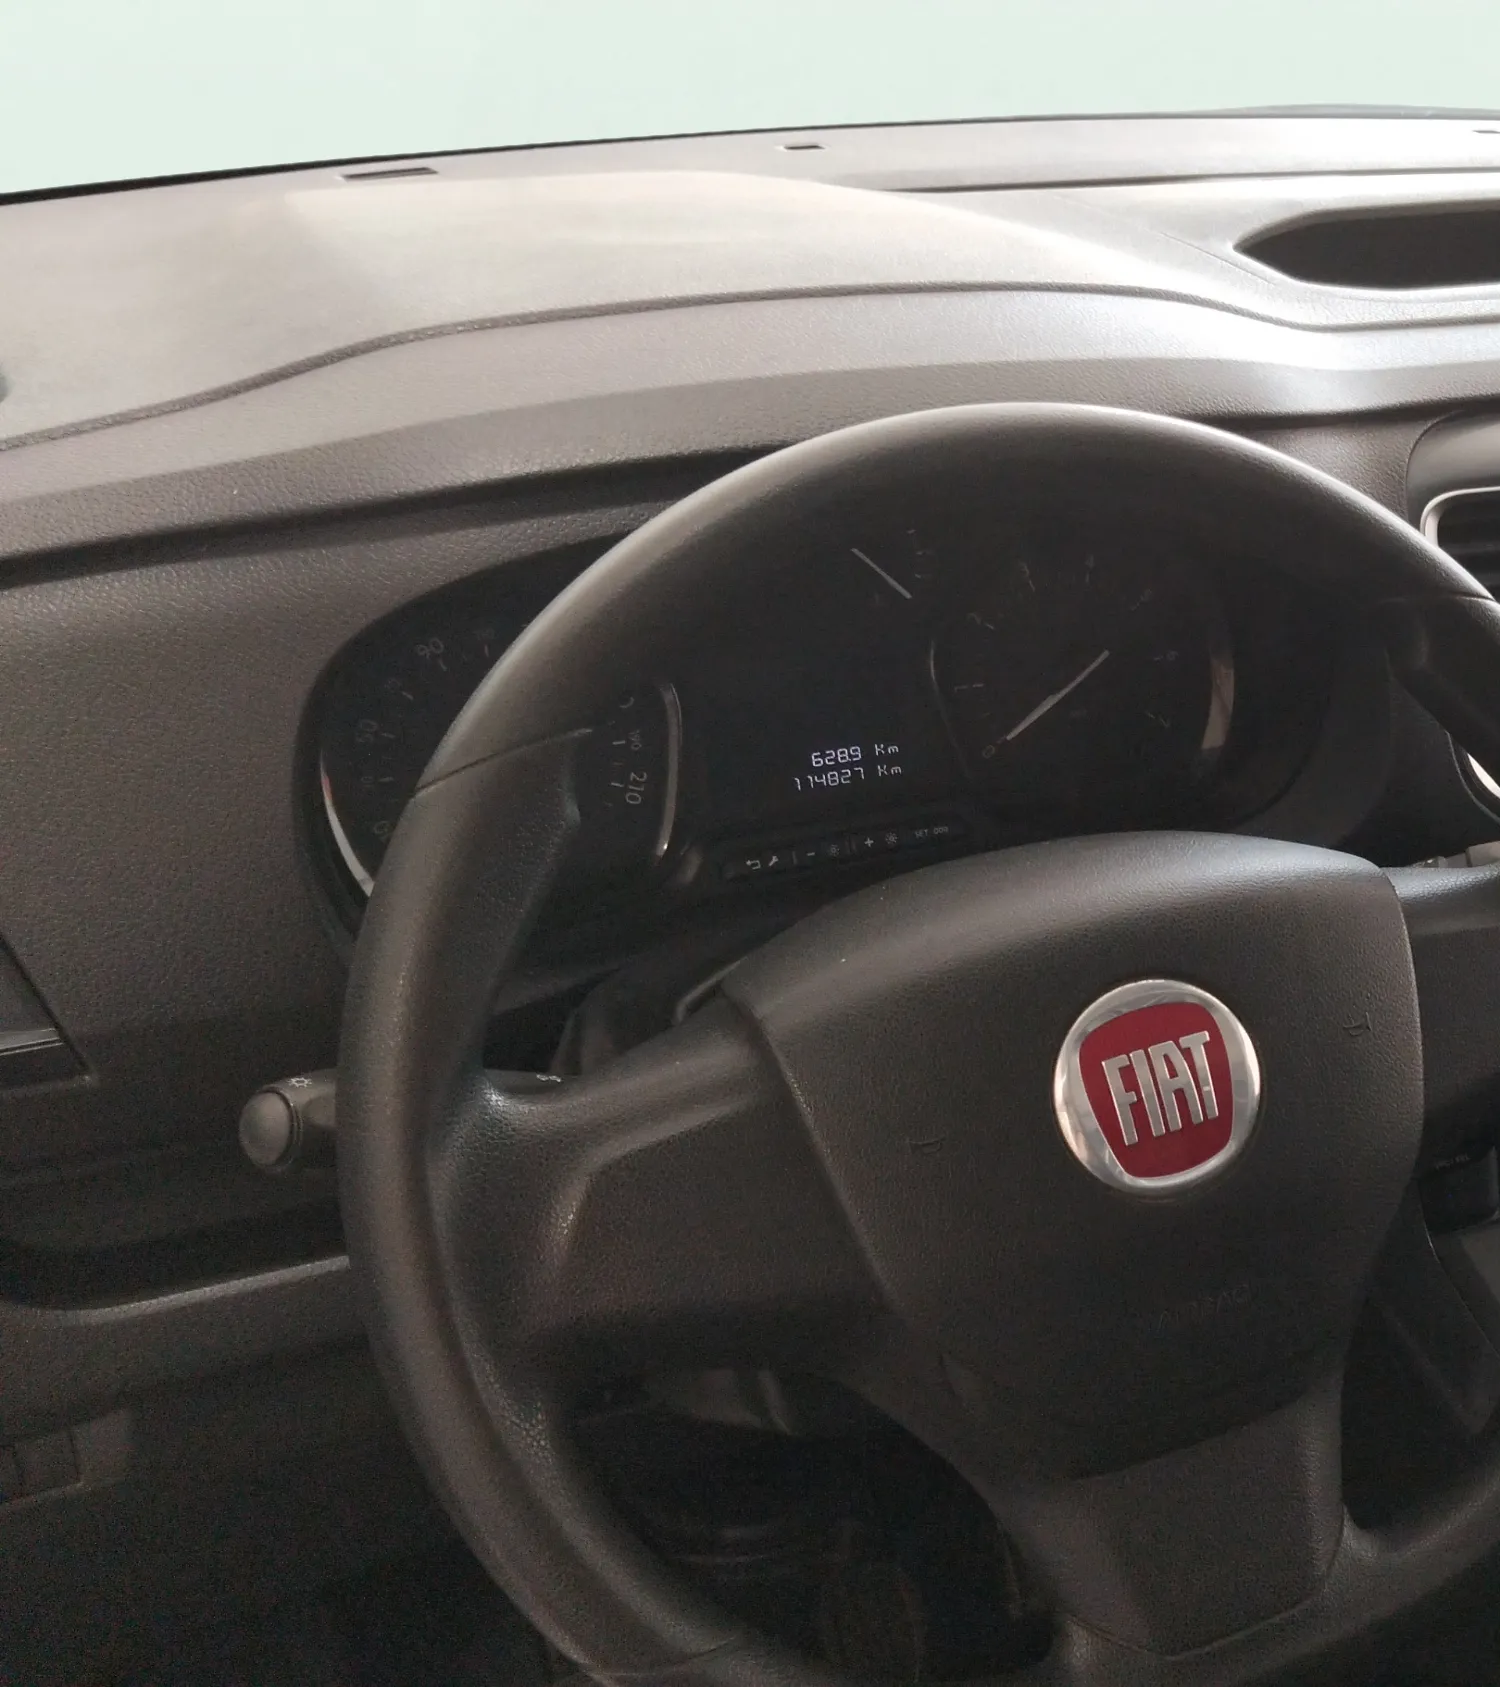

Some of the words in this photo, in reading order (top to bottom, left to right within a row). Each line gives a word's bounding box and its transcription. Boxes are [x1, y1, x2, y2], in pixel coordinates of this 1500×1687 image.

[415, 637, 443, 660] 90
[794, 766, 865, 791] 114827
[1102, 1030, 1219, 1146] FIAT
